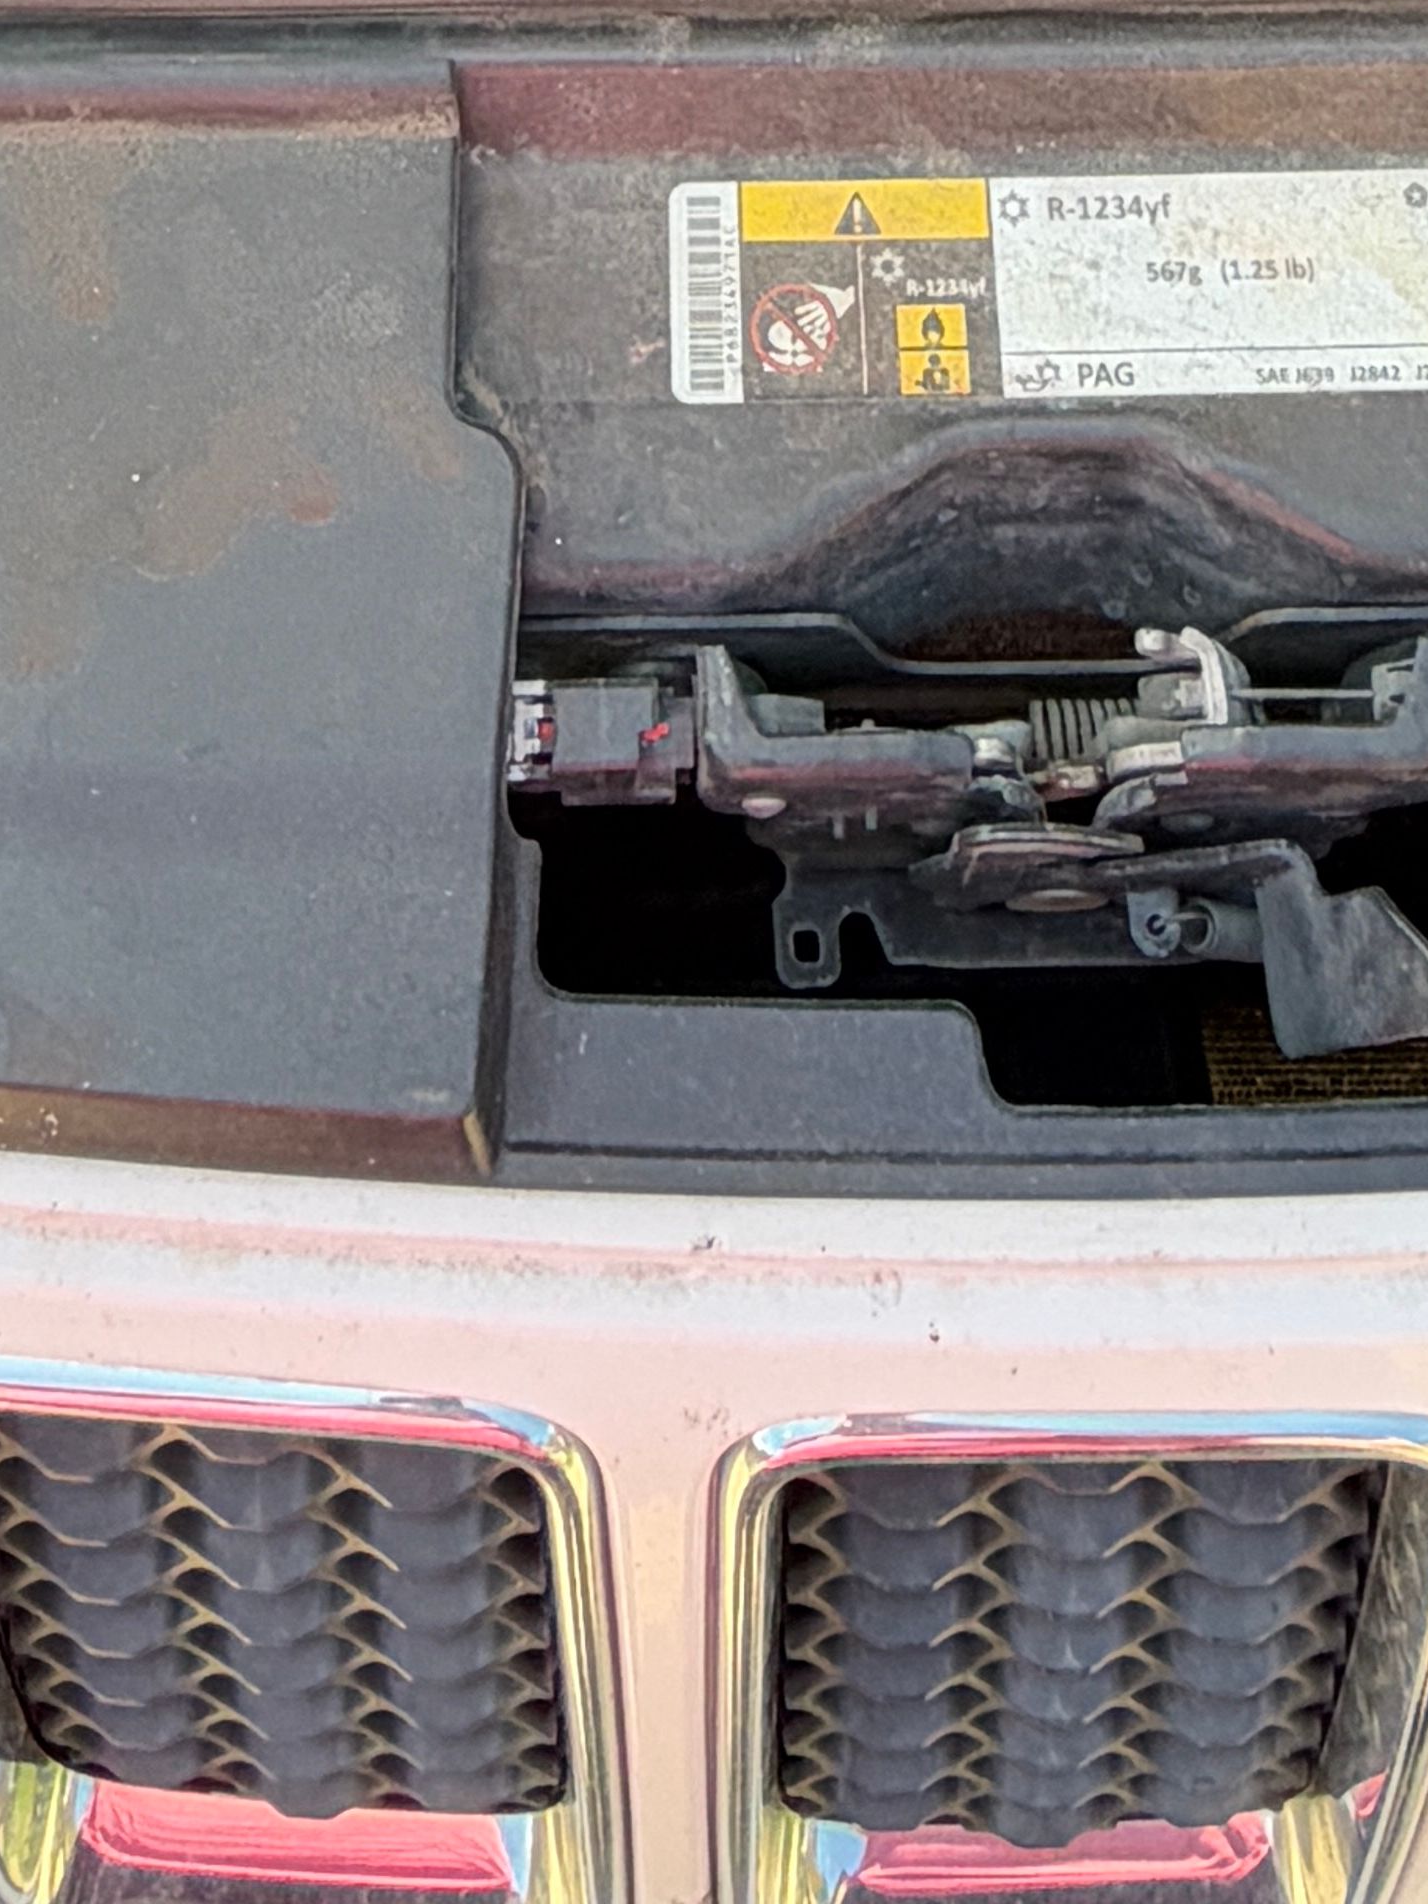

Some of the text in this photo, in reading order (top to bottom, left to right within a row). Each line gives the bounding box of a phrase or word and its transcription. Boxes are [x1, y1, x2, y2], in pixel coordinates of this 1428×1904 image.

[1047, 193, 1171, 225] R-1234yf
[1145, 256, 1316, 287] 567g (1.25 lb)
[1077, 361, 1136, 388] PAG
[1255, 366, 1290, 384] SAE
